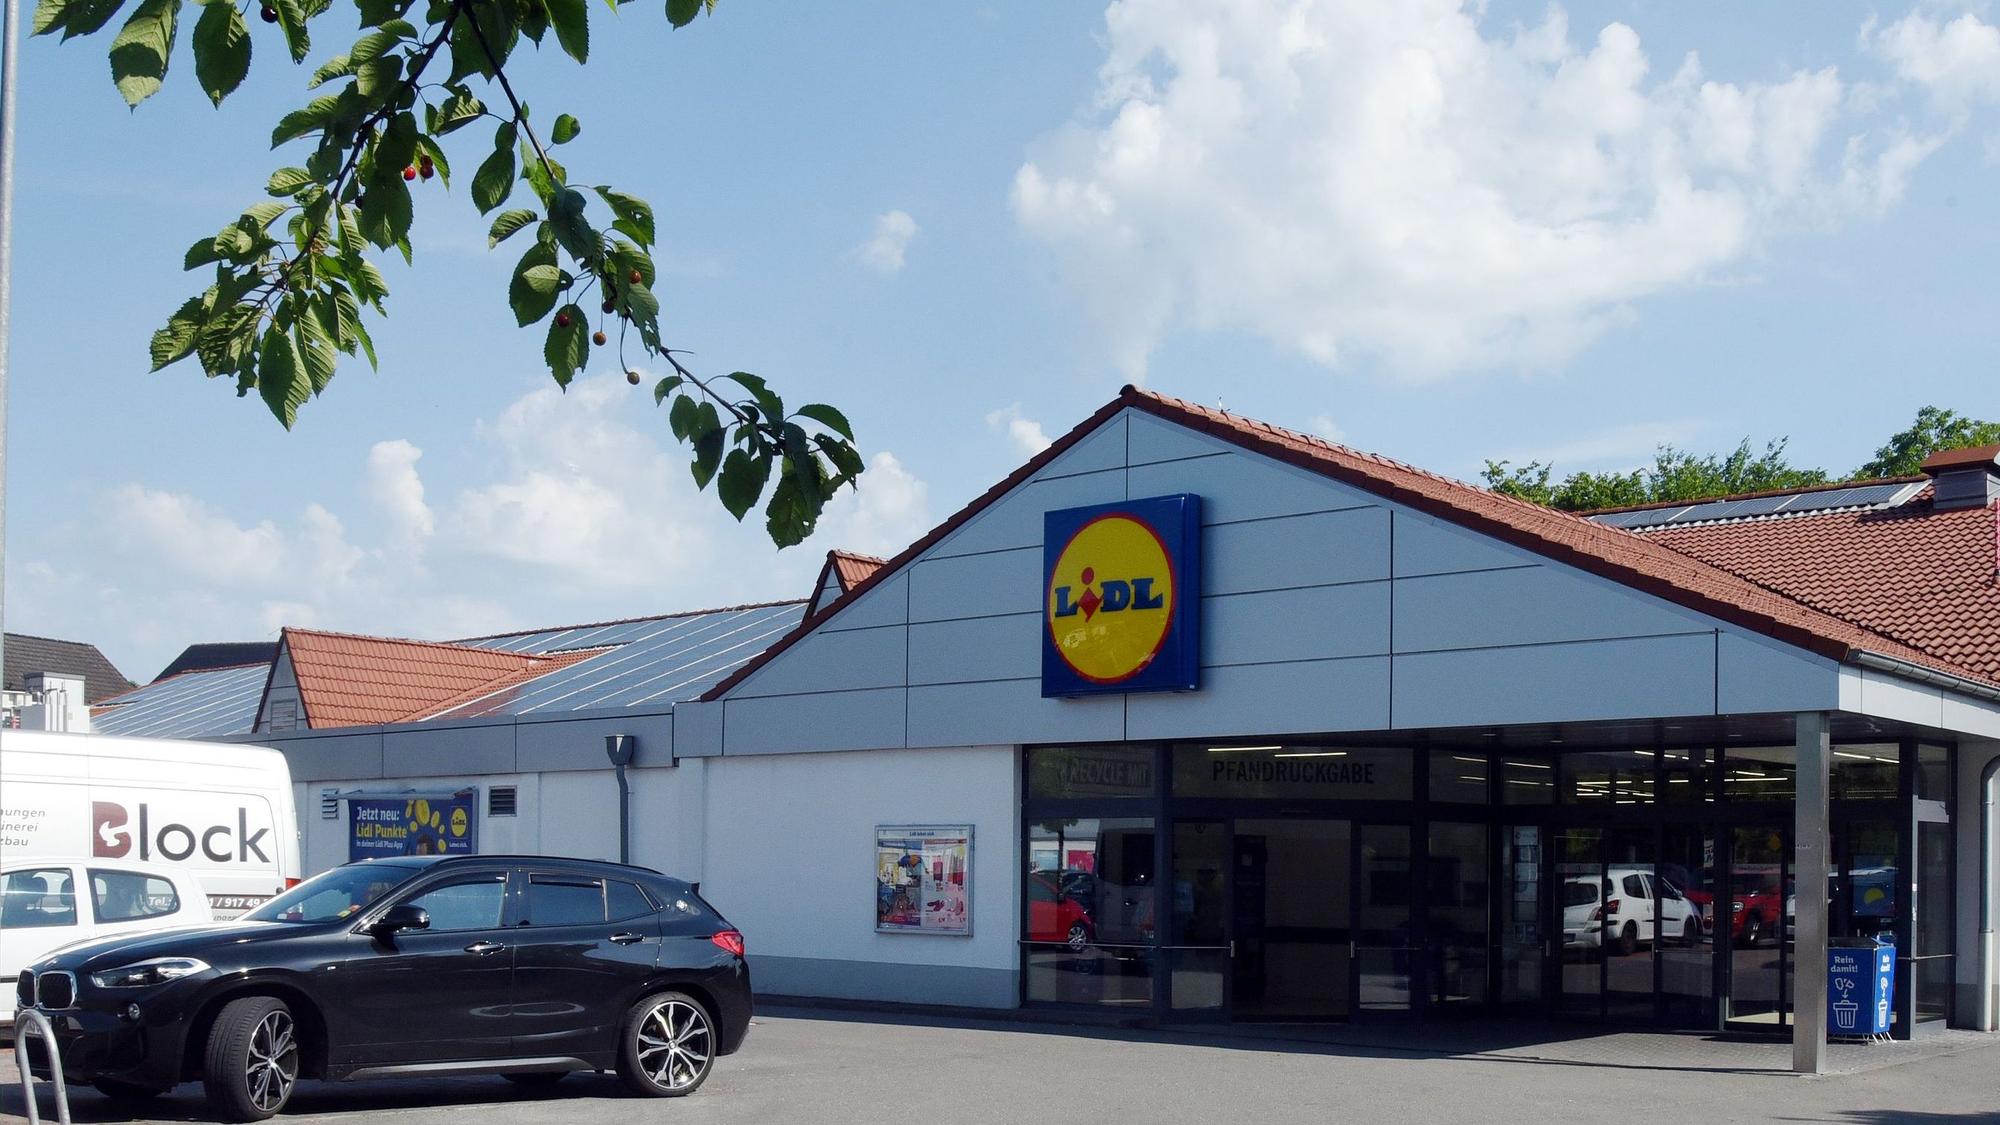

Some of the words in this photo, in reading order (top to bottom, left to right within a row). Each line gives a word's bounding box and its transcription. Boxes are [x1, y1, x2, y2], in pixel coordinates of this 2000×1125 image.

[356, 806, 379, 821] Jetzt
[380, 808, 400, 821] neu:
[92, 801, 271, 863] Block
[356, 823, 373, 838] Lidl
[224, 898, 245, 907] 917
[1834, 955, 1854, 963] Rein
[1830, 964, 1858, 972] damit!
